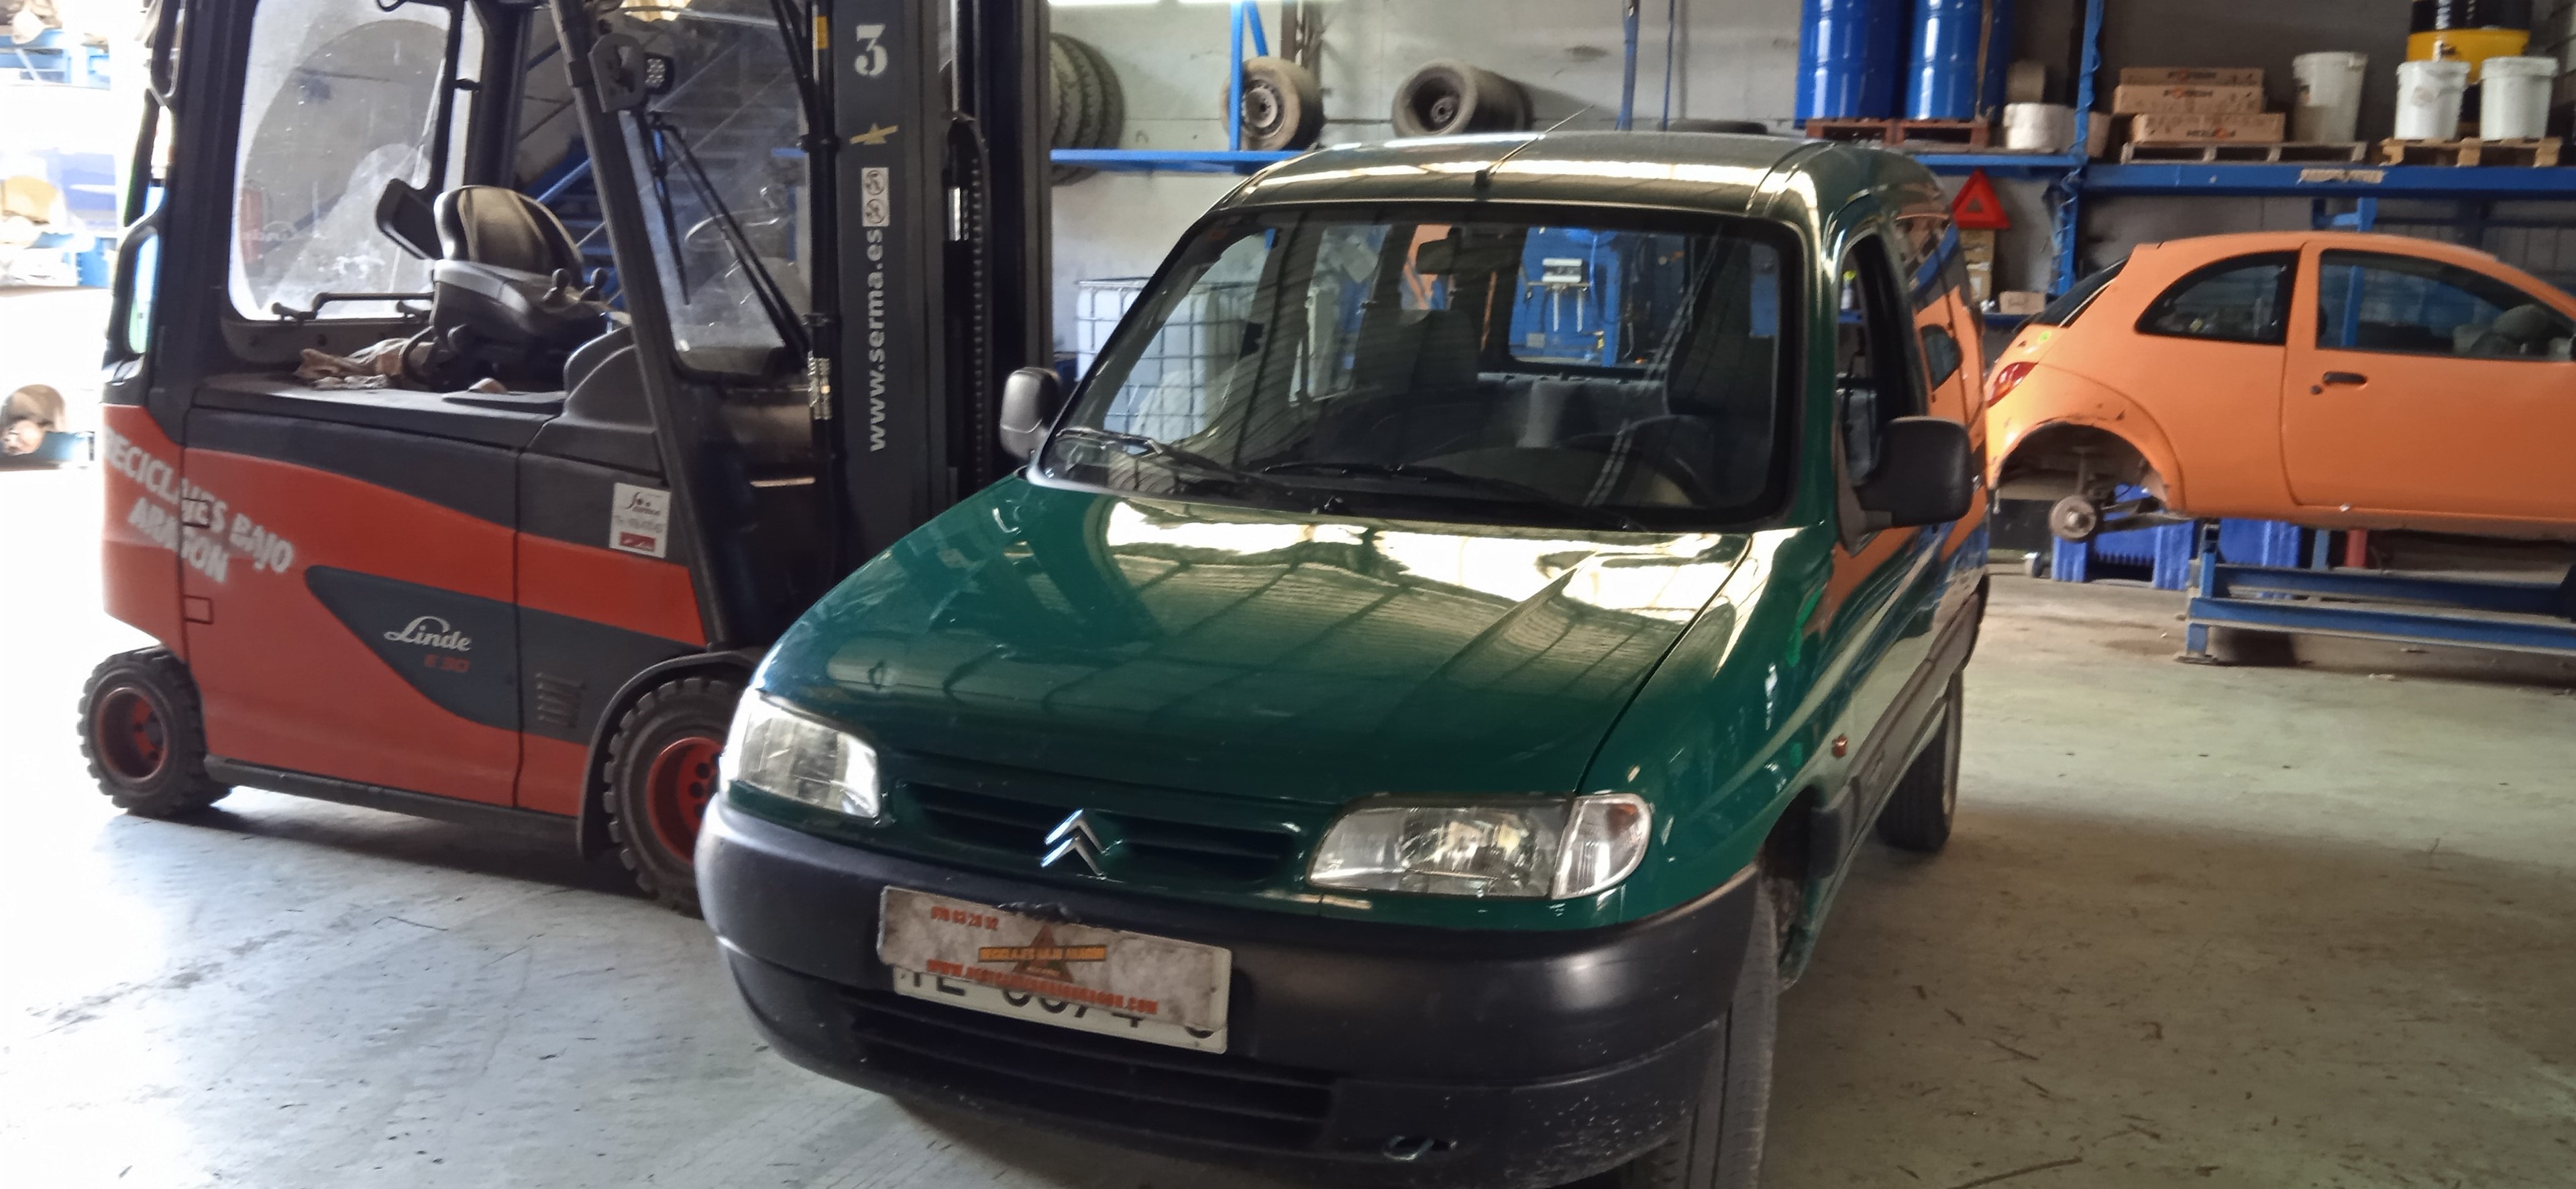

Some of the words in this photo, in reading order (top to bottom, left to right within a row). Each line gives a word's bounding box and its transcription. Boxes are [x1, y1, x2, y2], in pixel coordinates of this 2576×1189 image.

[855, 23, 888, 79] 3
[866, 229, 886, 452] www.serma.es
[383, 616, 472, 652] Linde
